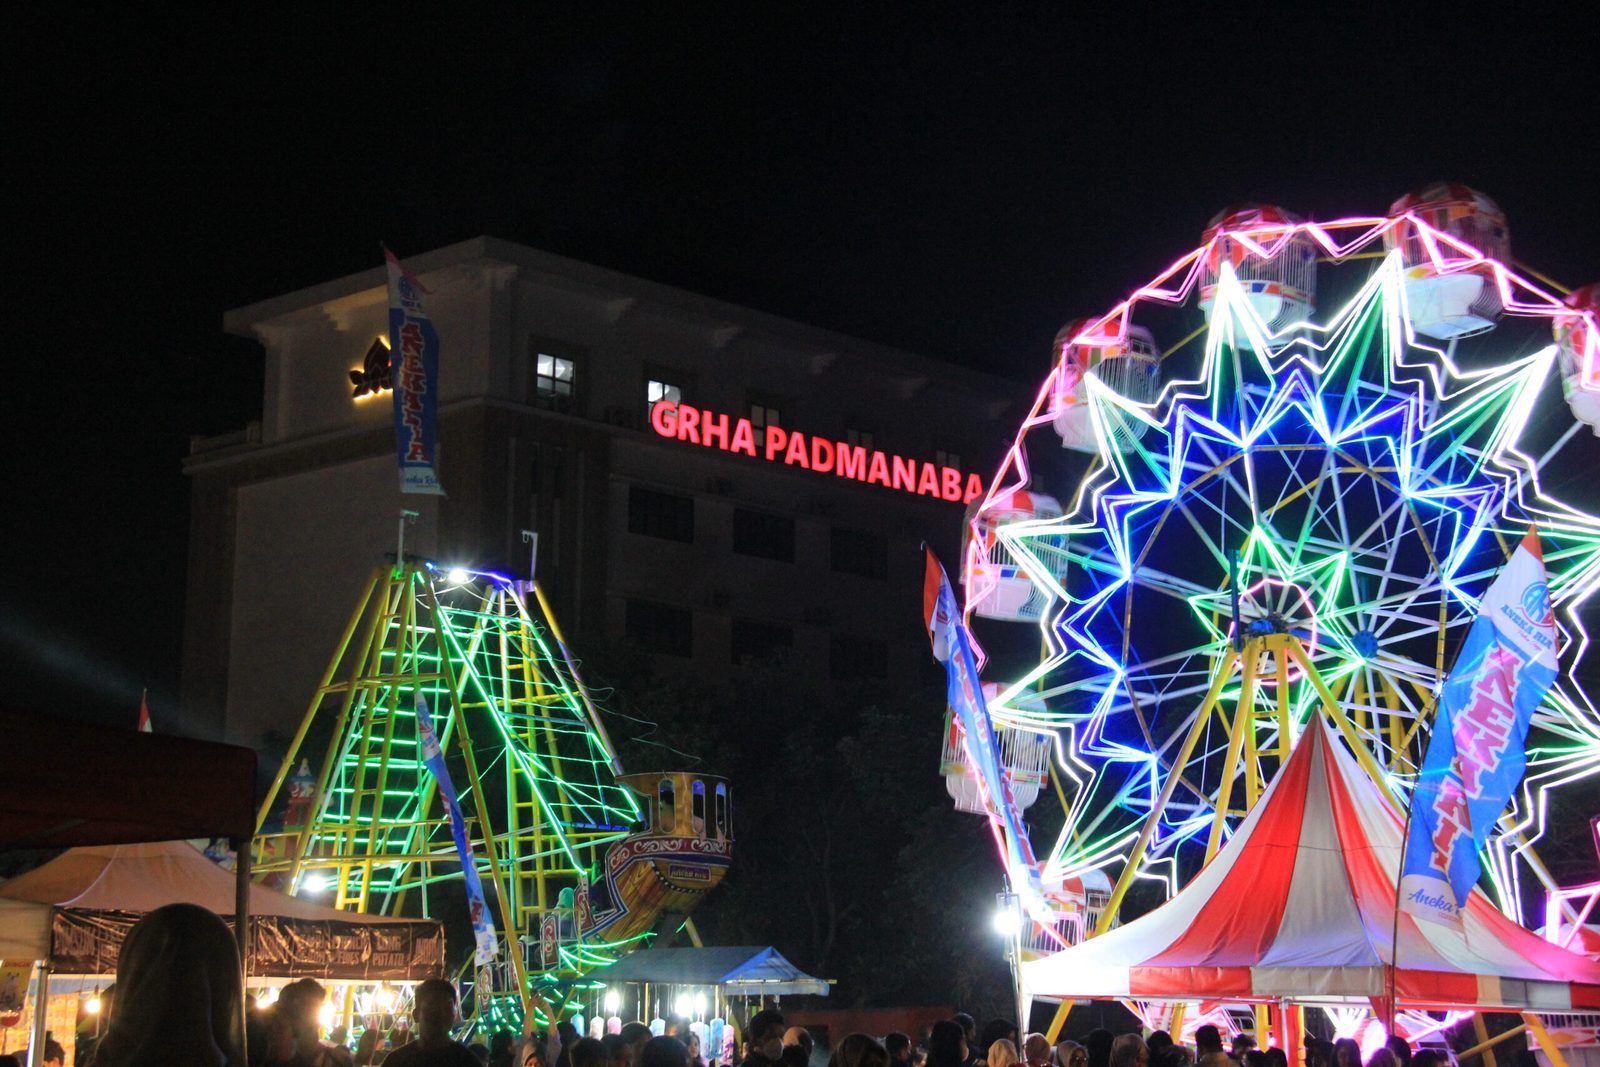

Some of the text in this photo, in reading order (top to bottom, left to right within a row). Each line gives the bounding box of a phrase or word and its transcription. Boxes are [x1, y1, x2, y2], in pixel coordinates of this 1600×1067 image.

[651, 400, 983, 505] GRHA PADMANABA
[1501, 604, 1534, 635] ANEKA
[1533, 631, 1553, 650] RIA
[1408, 888, 1453, 913] Aneka
[372, 952, 405, 967] POTATO
